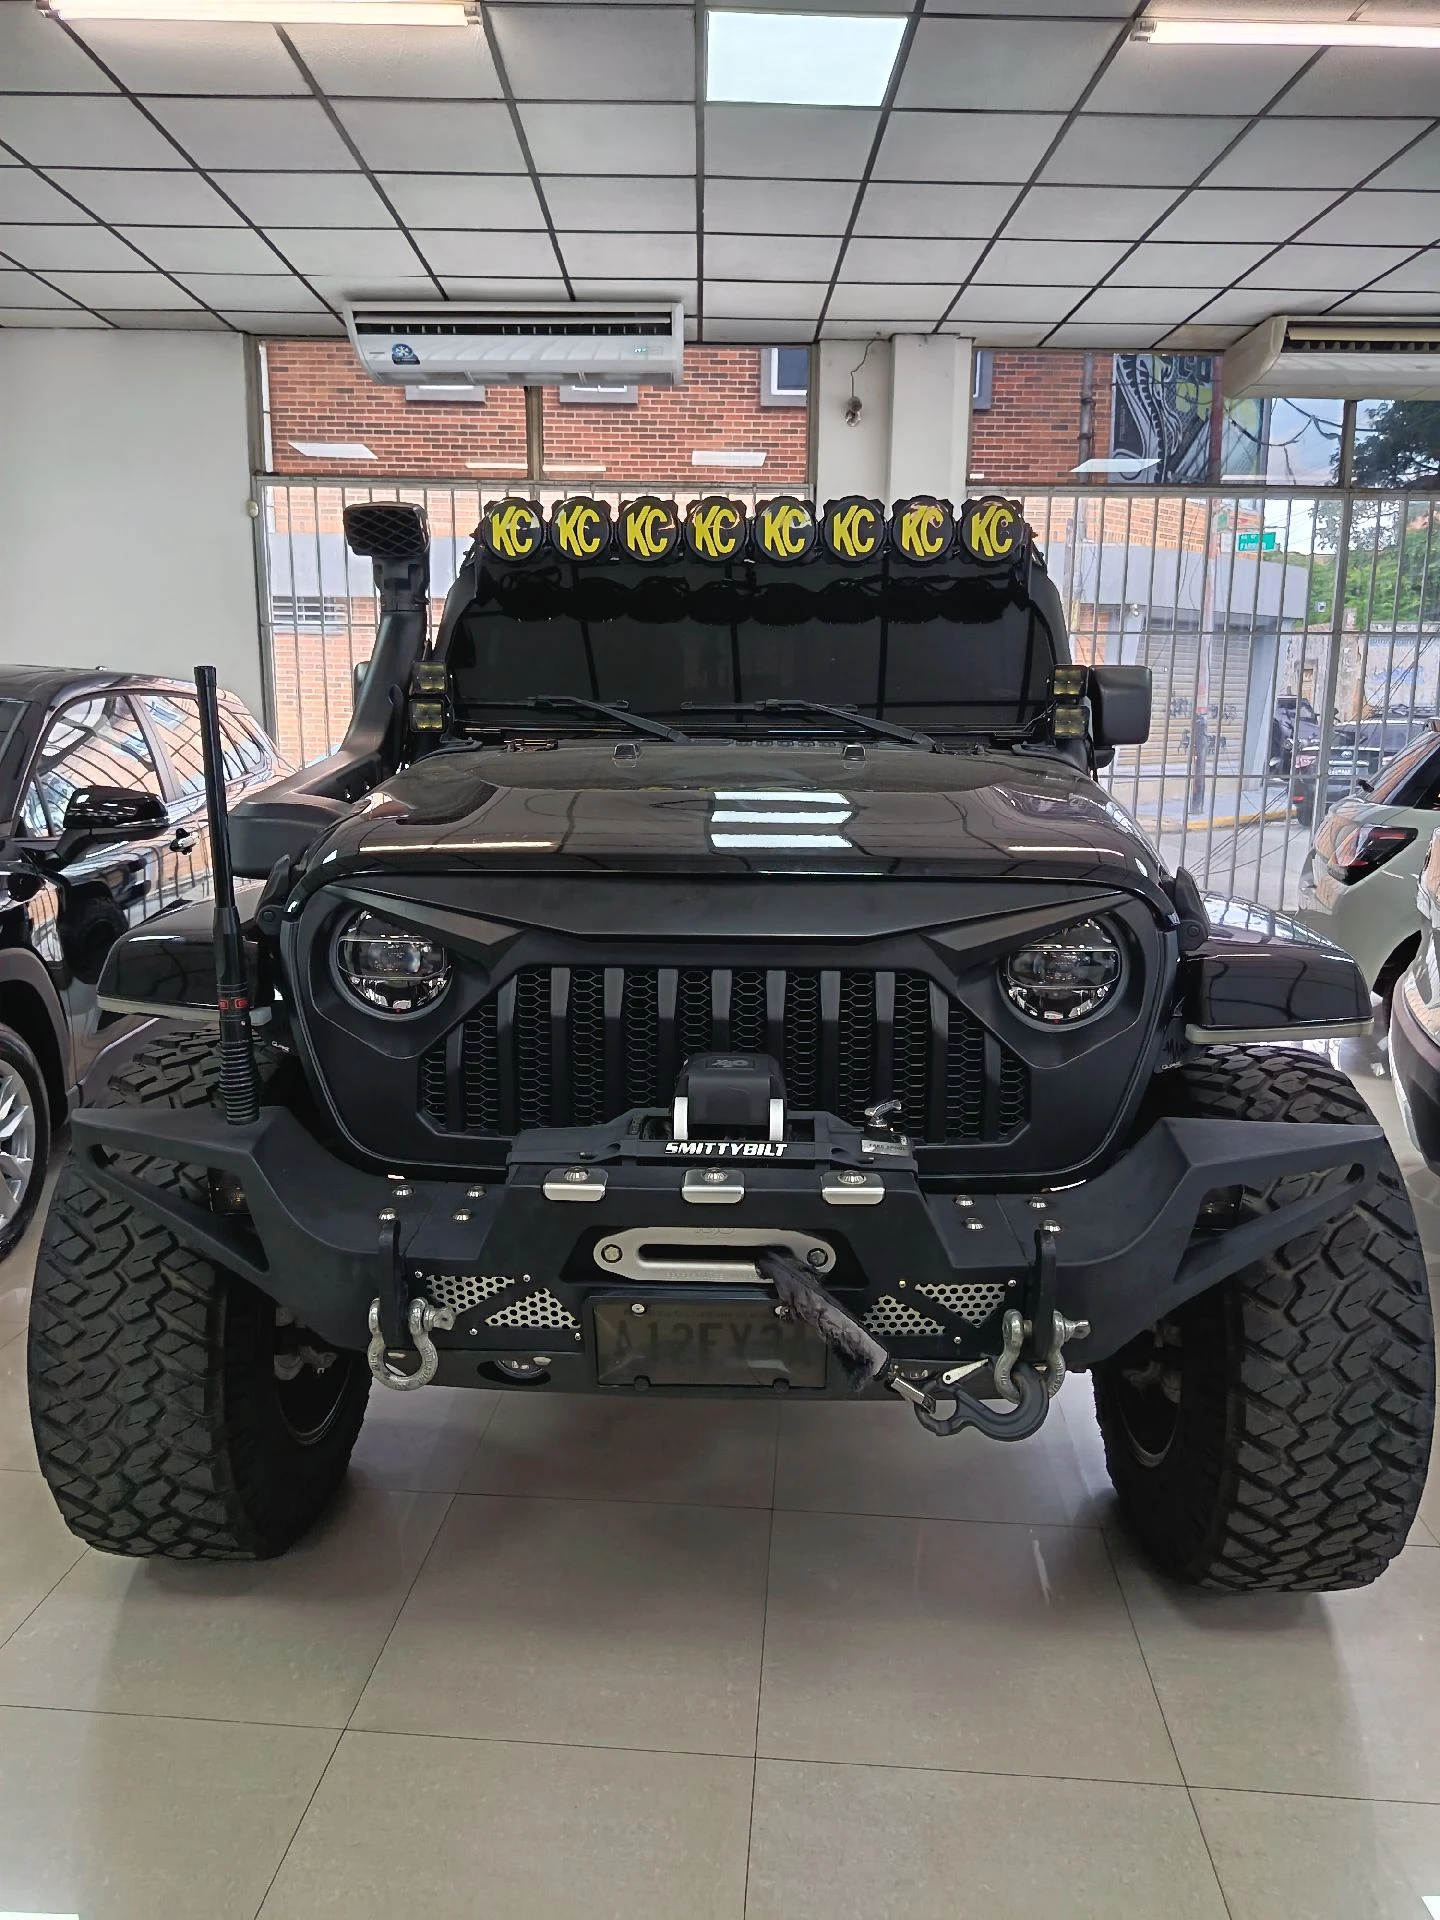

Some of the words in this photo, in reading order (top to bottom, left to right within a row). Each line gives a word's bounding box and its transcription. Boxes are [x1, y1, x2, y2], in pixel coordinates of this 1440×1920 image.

[491, 505, 533, 556] KC
[559, 506, 600, 557] KC
[626, 505, 668, 556] KC
[693, 506, 736, 556] KC
[764, 506, 805, 555] KC
[834, 504, 875, 557] KC
[901, 504, 944, 557] KC
[972, 506, 1014, 556] KC
[664, 1142, 788, 1157] SMITTYBILT
